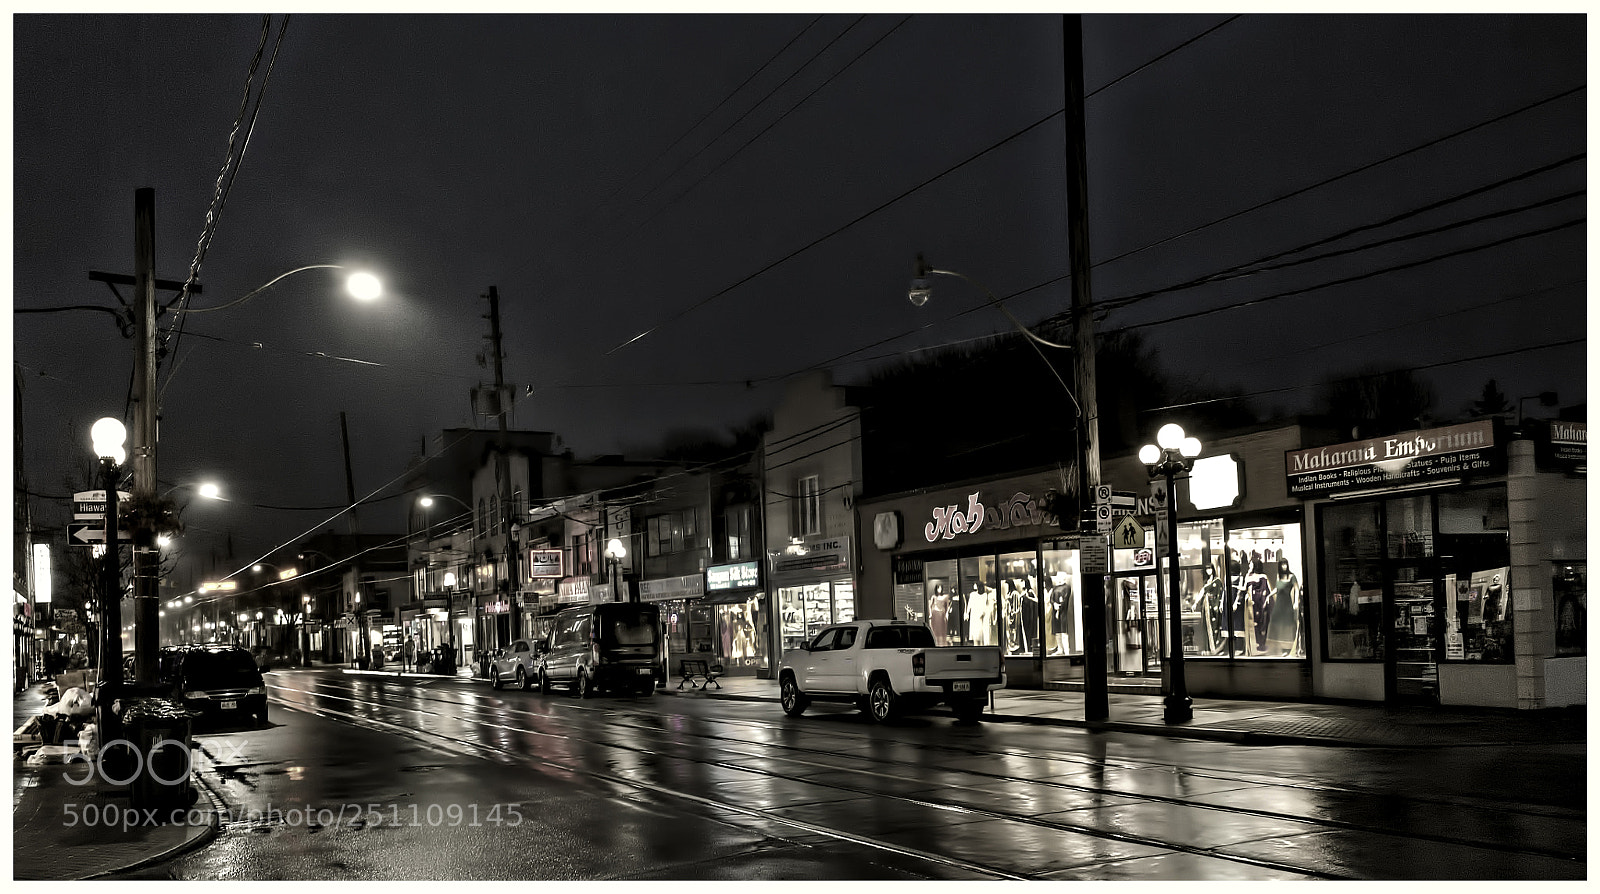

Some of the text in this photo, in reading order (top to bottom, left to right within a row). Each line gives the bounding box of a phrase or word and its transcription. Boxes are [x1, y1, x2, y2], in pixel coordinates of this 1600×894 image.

[1293, 431, 1484, 471] Maharani Emporium
[1292, 460, 1491, 492] Musical Instruments Wooden Handicrafts Souvenirs & Gifts
[1298, 475, 1317, 484] Indian
[1319, 472, 1337, 481] Books
[1343, 468, 1371, 477] Religious
[1440, 455, 1457, 465] Puja
[1459, 452, 1480, 462] Items
[823, 541, 842, 550] INC.
